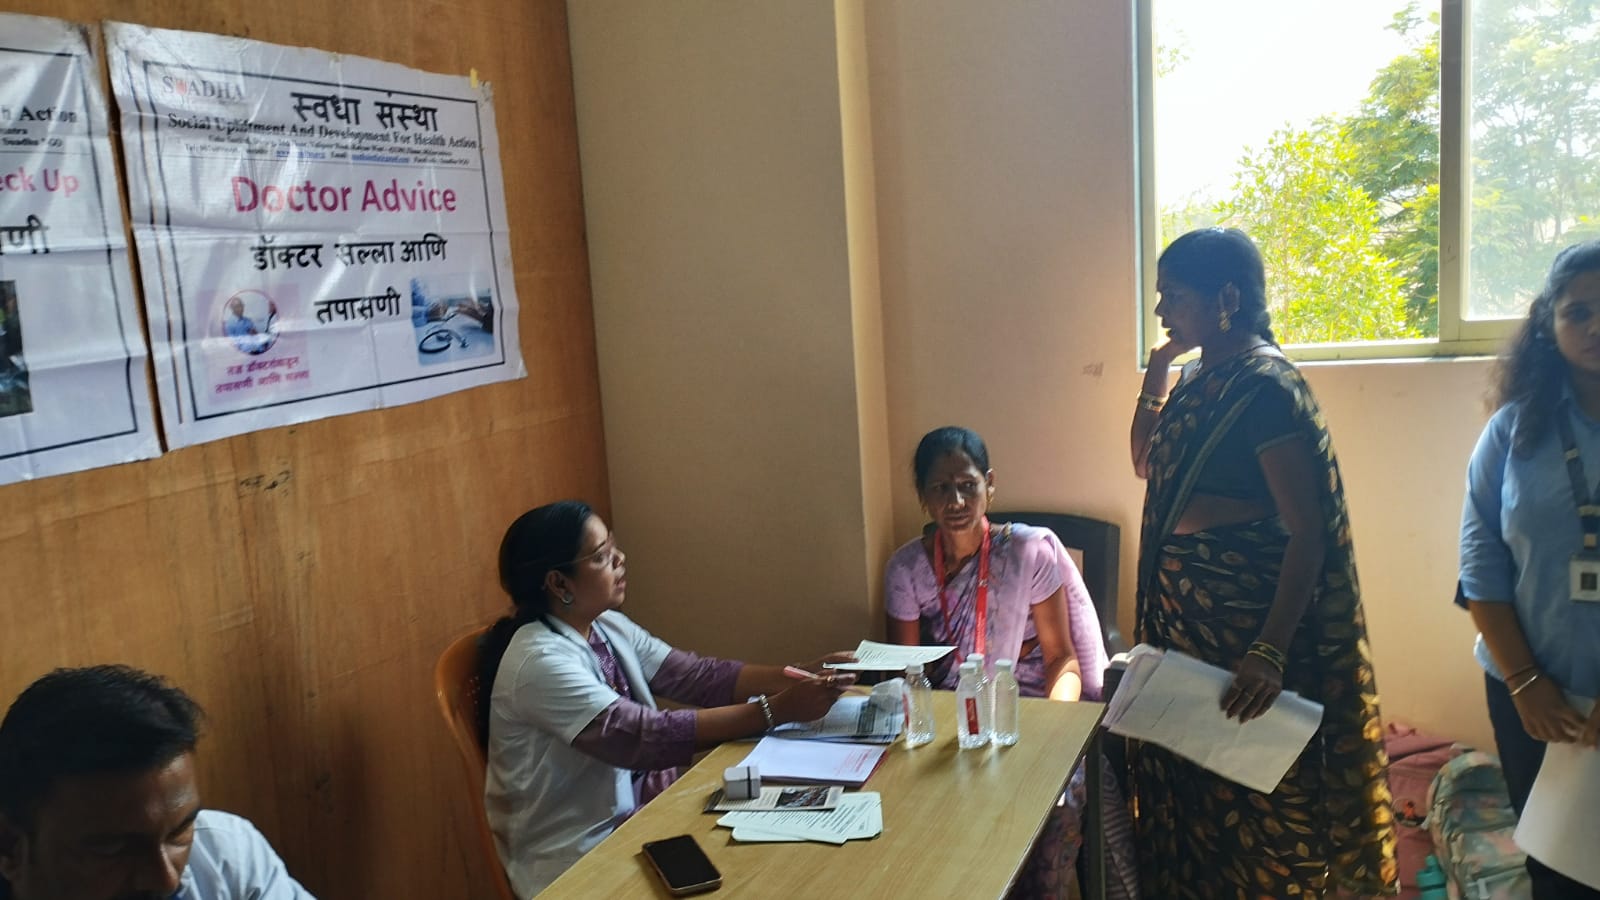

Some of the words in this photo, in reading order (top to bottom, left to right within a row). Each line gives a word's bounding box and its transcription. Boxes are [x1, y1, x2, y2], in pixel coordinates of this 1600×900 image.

[168, 112, 211, 130] Social
[290, 123, 315, 138] And
[318, 124, 392, 143] Development
[393, 132, 412, 145] For
[414, 132, 447, 147] Health
[448, 136, 478, 149] Action
[290, 91, 361, 126] स्वधा
[374, 92, 438, 132] संस्था
[0, 166, 36, 192] ck
[43, 168, 79, 198] Up
[231, 175, 353, 213] Doctor
[361, 178, 457, 213] Advice
[250, 234, 323, 271] डॉक्टर
[333, 241, 395, 267] सल्ला
[400, 232, 448, 263] आणि
[313, 286, 402, 324] तपासणी
